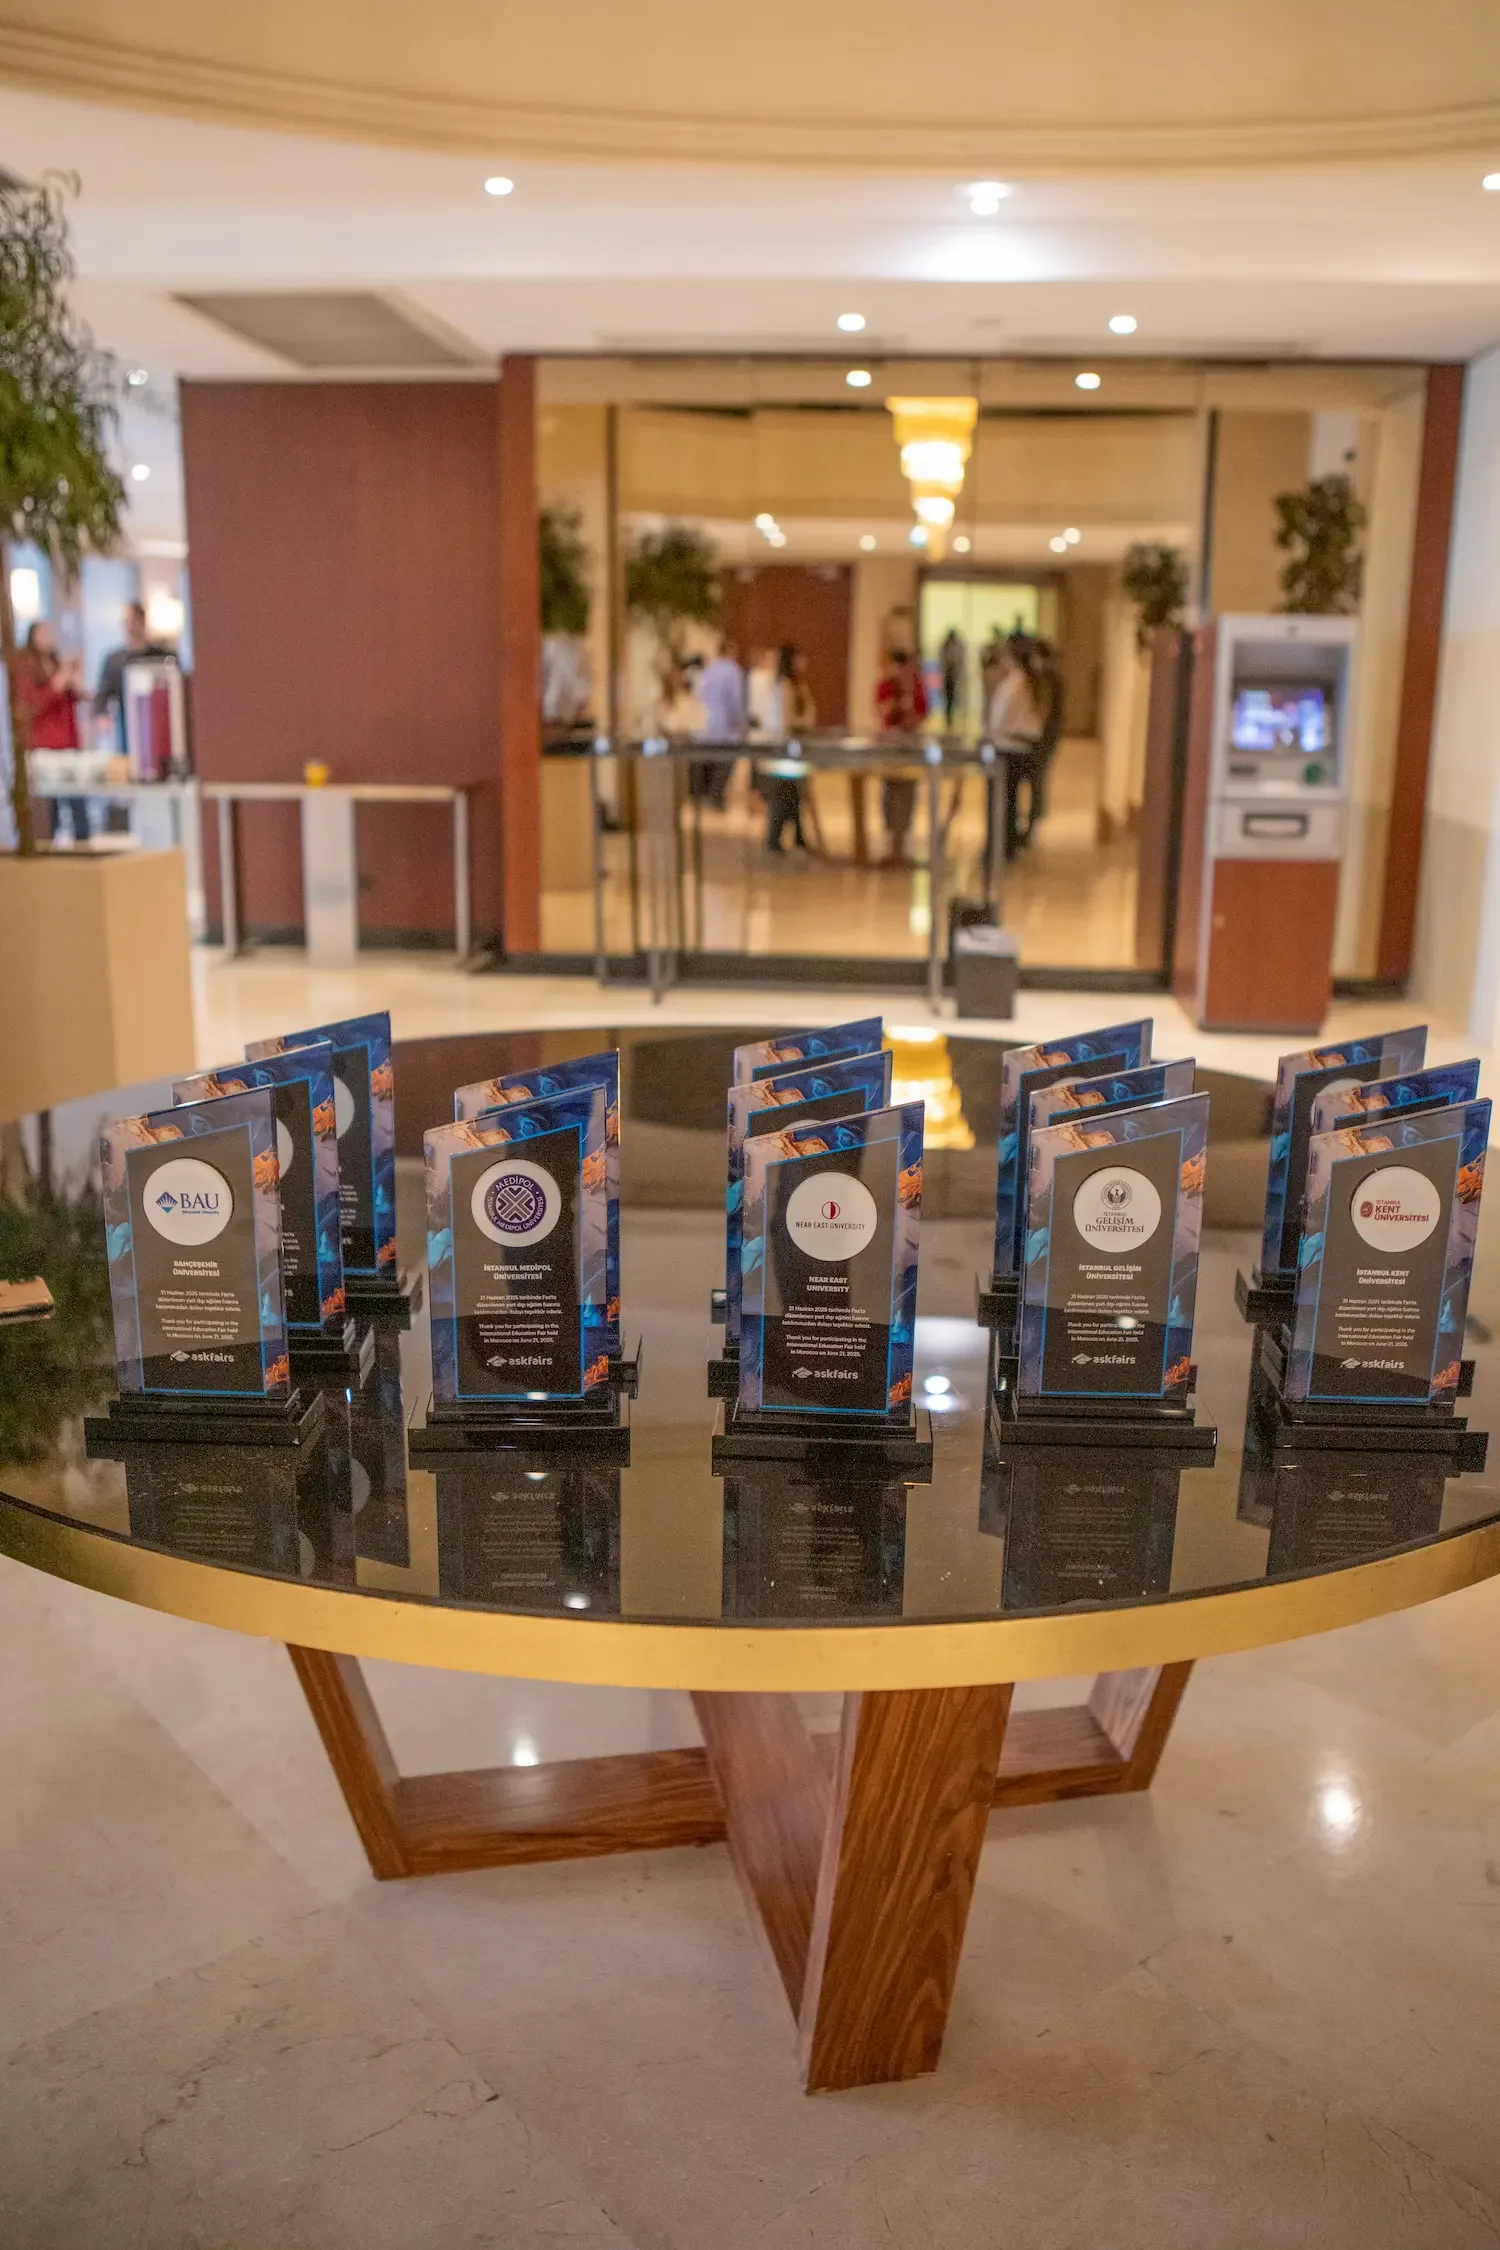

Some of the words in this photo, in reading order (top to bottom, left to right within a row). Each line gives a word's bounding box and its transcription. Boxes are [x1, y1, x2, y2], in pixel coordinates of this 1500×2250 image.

[495, 1176, 534, 1191] MEDİPOL
[180, 1193, 220, 1210] BAU
[1096, 1216, 1134, 1225] GELİŞİM
[1374, 1214, 1429, 1222] ÜNİVERSİTESİ
[830, 1222, 865, 1230] UNIVERSITY
[1085, 1224, 1144, 1232] ÜNİVERSİTESİ
[1113, 1264, 1142, 1272] GELİŞİM
[1356, 1268, 1390, 1276] İSTANBUL
[494, 1272, 542, 1280] ÜNİVERSİTESİ
[1086, 1272, 1133, 1280] ÜNİVERSİTESİ
[1358, 1277, 1406, 1285] ÜNİVERSİTESİ
[192, 1352, 234, 1362] askfairs
[509, 1356, 553, 1365] askfairs
[1093, 1354, 1136, 1364] askfairs
[1362, 1360, 1404, 1369] askfairs
[814, 1369, 858, 1380] askfairs
